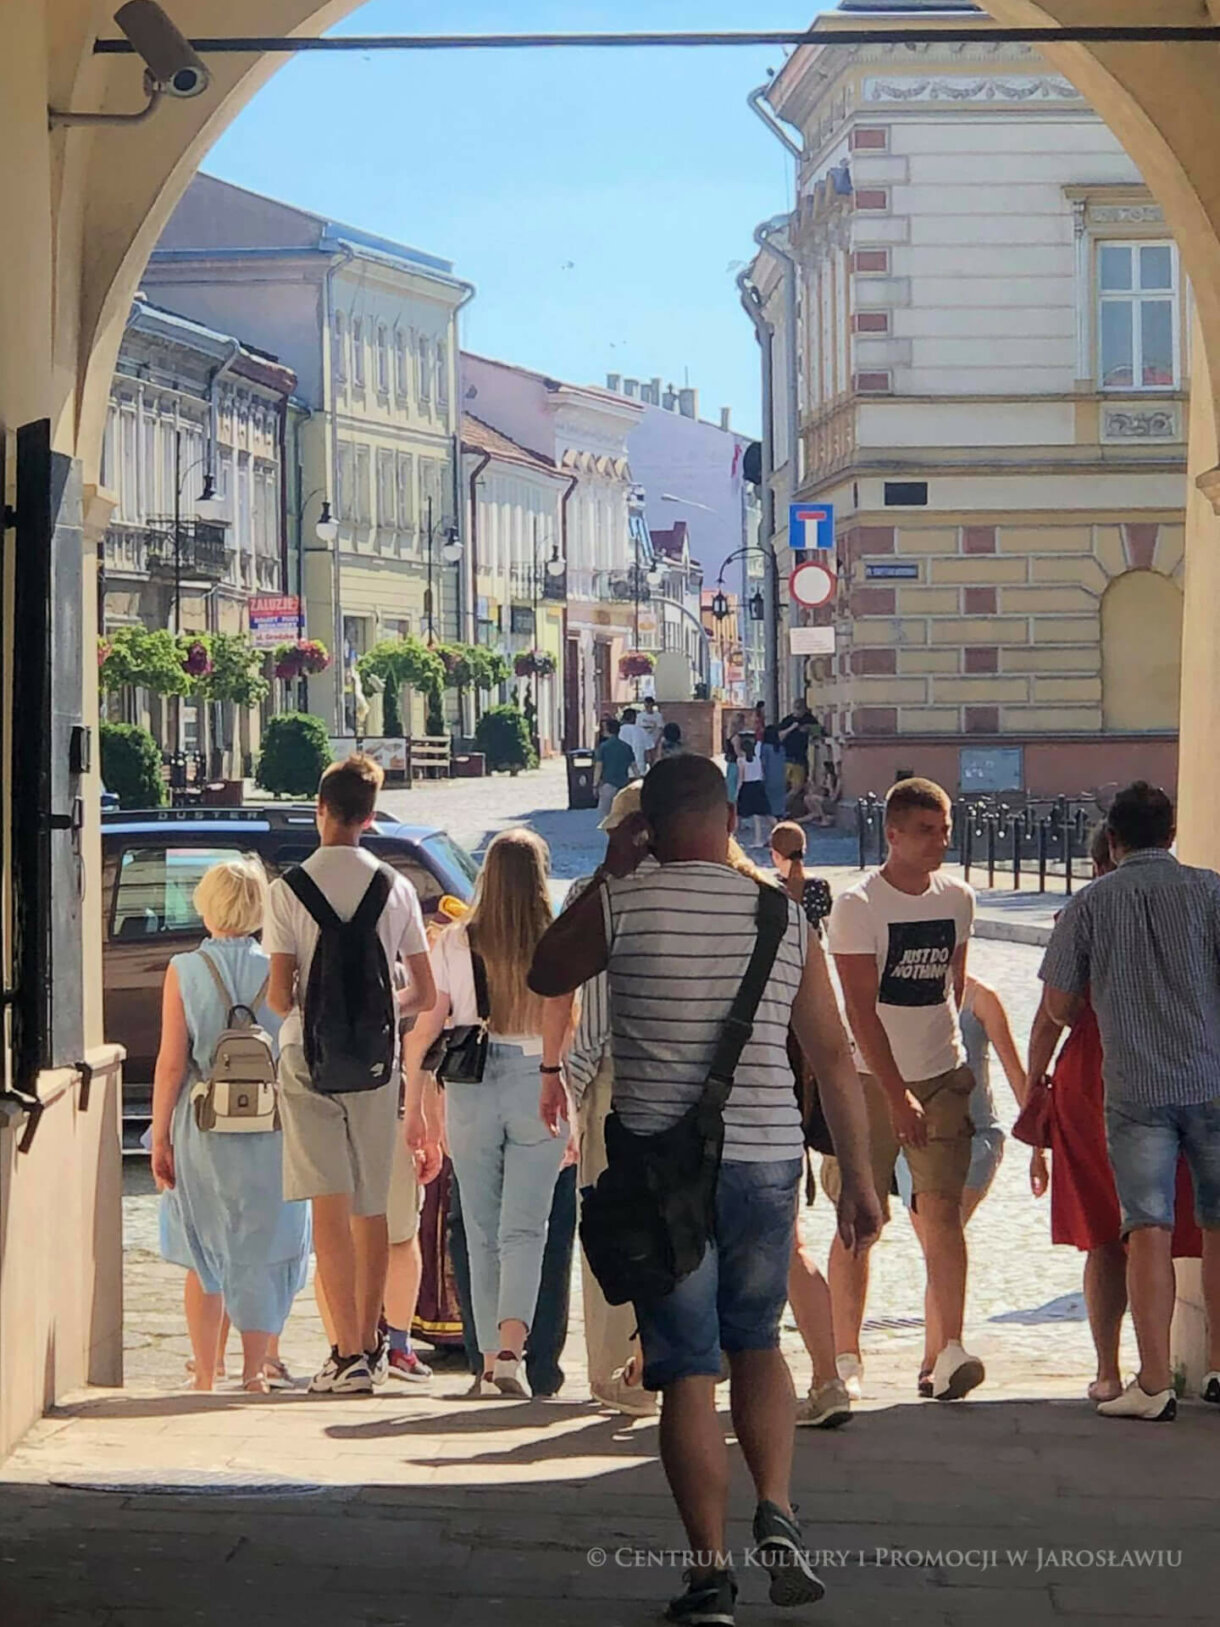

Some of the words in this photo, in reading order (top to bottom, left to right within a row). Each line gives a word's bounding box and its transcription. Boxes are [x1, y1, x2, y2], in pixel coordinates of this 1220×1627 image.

[158, 811, 258, 820] DUSTER
[900, 949, 930, 964] JUST
[929, 947, 949, 963] DO
